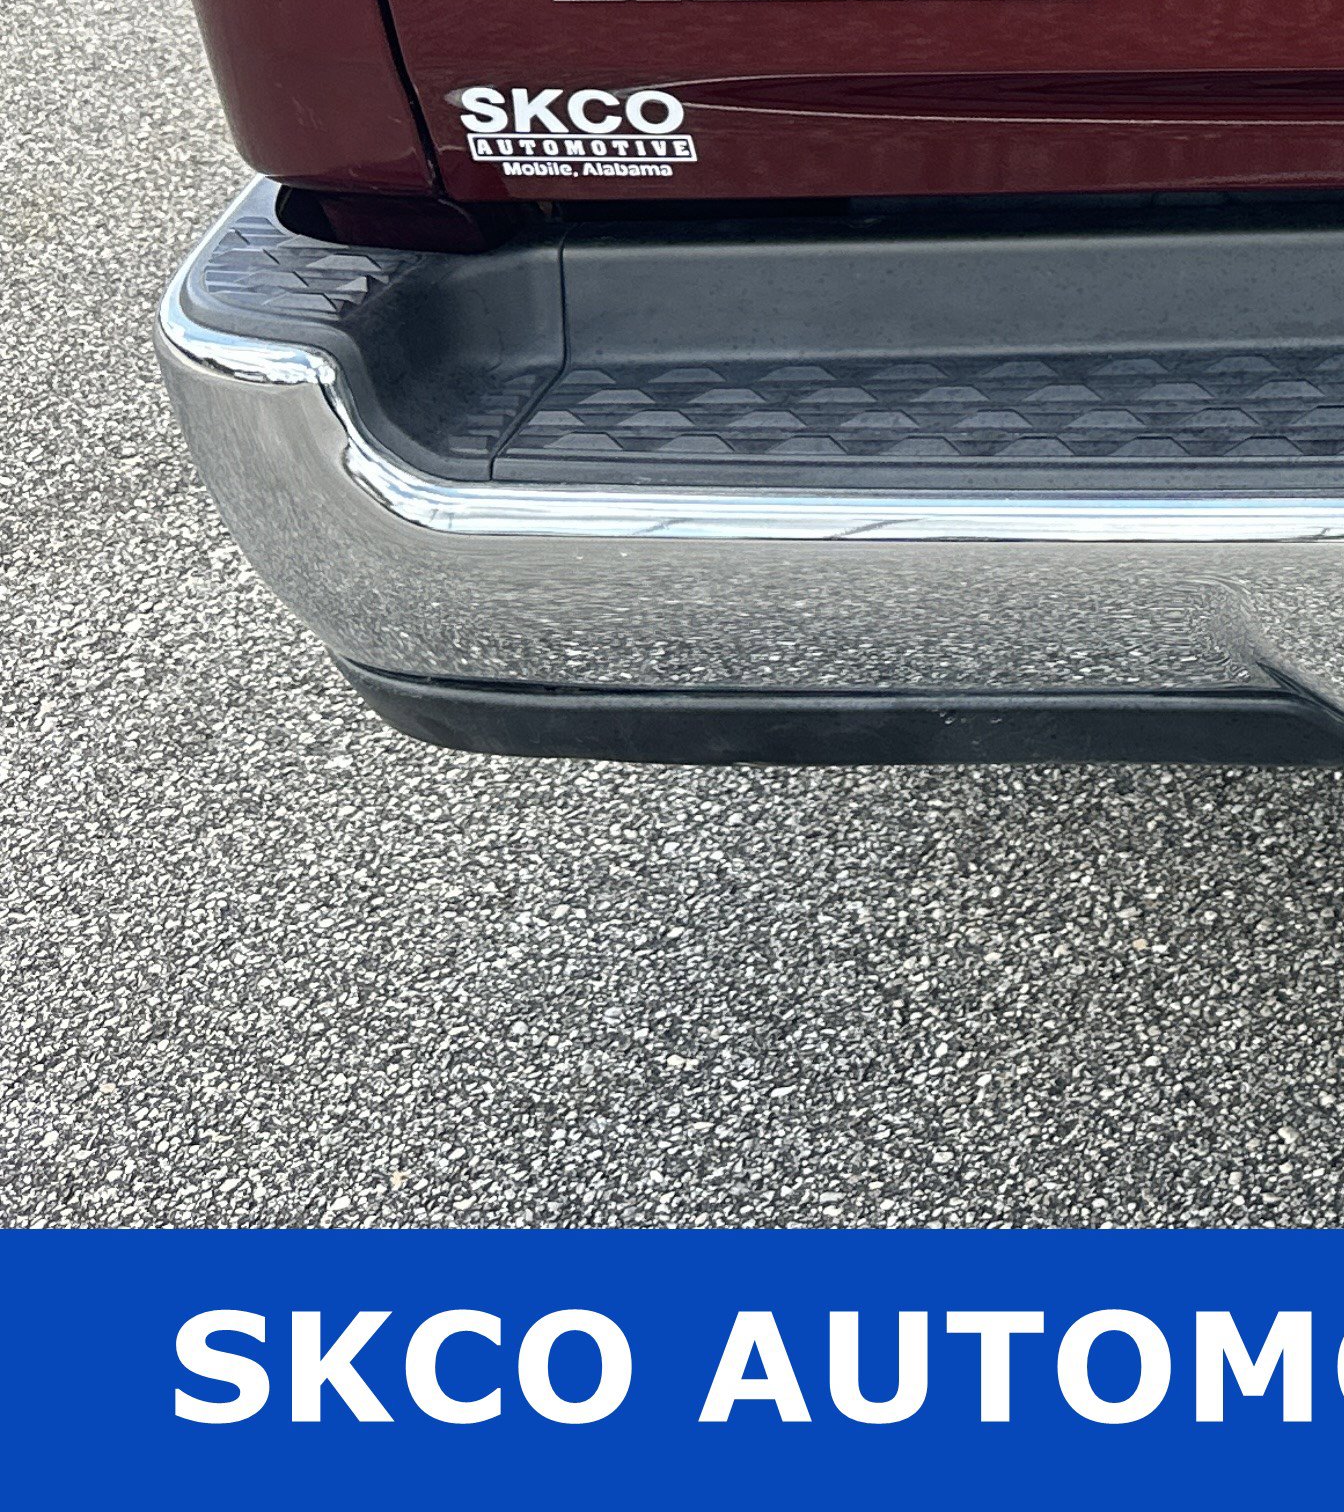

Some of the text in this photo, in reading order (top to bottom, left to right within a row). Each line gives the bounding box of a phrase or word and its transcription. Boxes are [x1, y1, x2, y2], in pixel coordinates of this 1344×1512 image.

[460, 87, 685, 134] SKCO
[476, 139, 691, 156] AUTOMOTIVE
[502, 161, 673, 178] Mobile, Alabama
